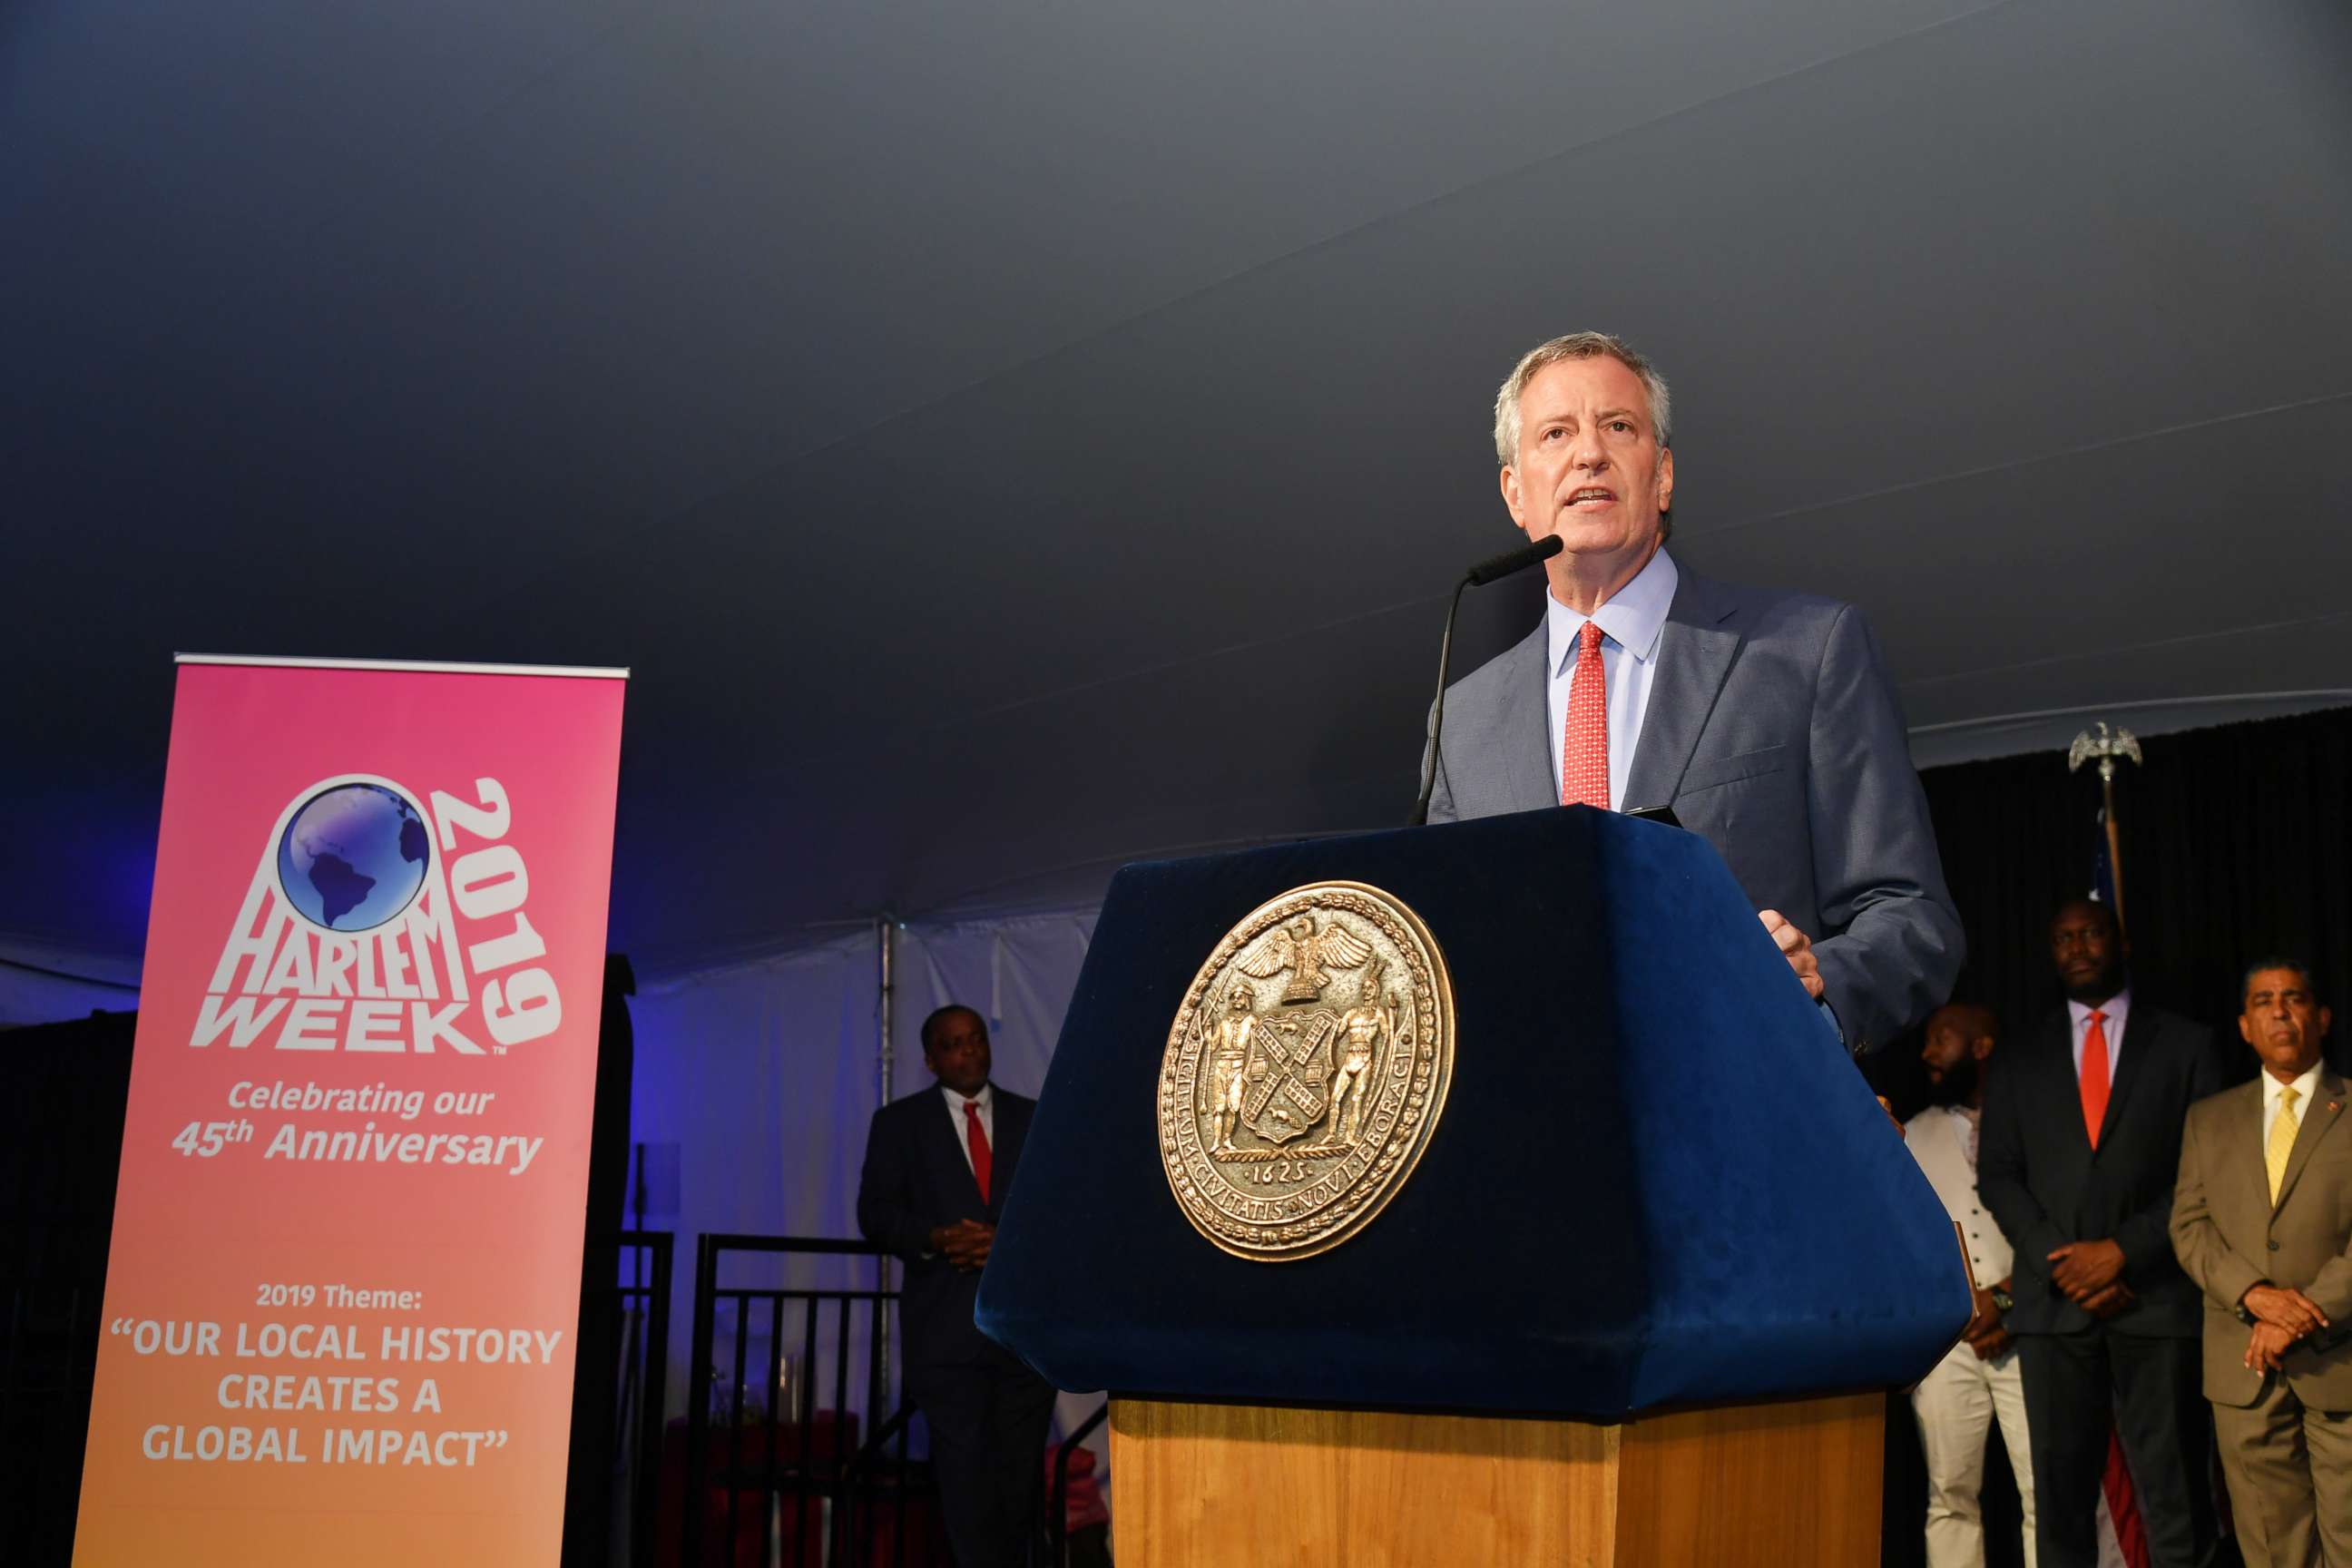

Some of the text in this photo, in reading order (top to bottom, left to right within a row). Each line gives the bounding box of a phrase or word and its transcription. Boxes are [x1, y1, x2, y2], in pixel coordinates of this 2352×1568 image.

[208, 871, 469, 1002] HARLEM
[431, 777, 562, 1047] 2019
[190, 995, 486, 1054] WEEK
[229, 1081, 495, 1120] Celebrating our
[172, 1119, 543, 1174] 45th Anniversary
[1194, 1163, 1283, 1220] CIVITATIS
[1298, 1163, 1354, 1214] NOVI
[1357, 1053, 1412, 1162] EBORACI
[256, 1284, 421, 1309] 2019 Theme:
[111, 1318, 563, 1364] “OUR LOCAL HISTORY
[217, 1374, 442, 1414] CREATES A
[142, 1426, 508, 1466] GLOBAL IMPACT”
